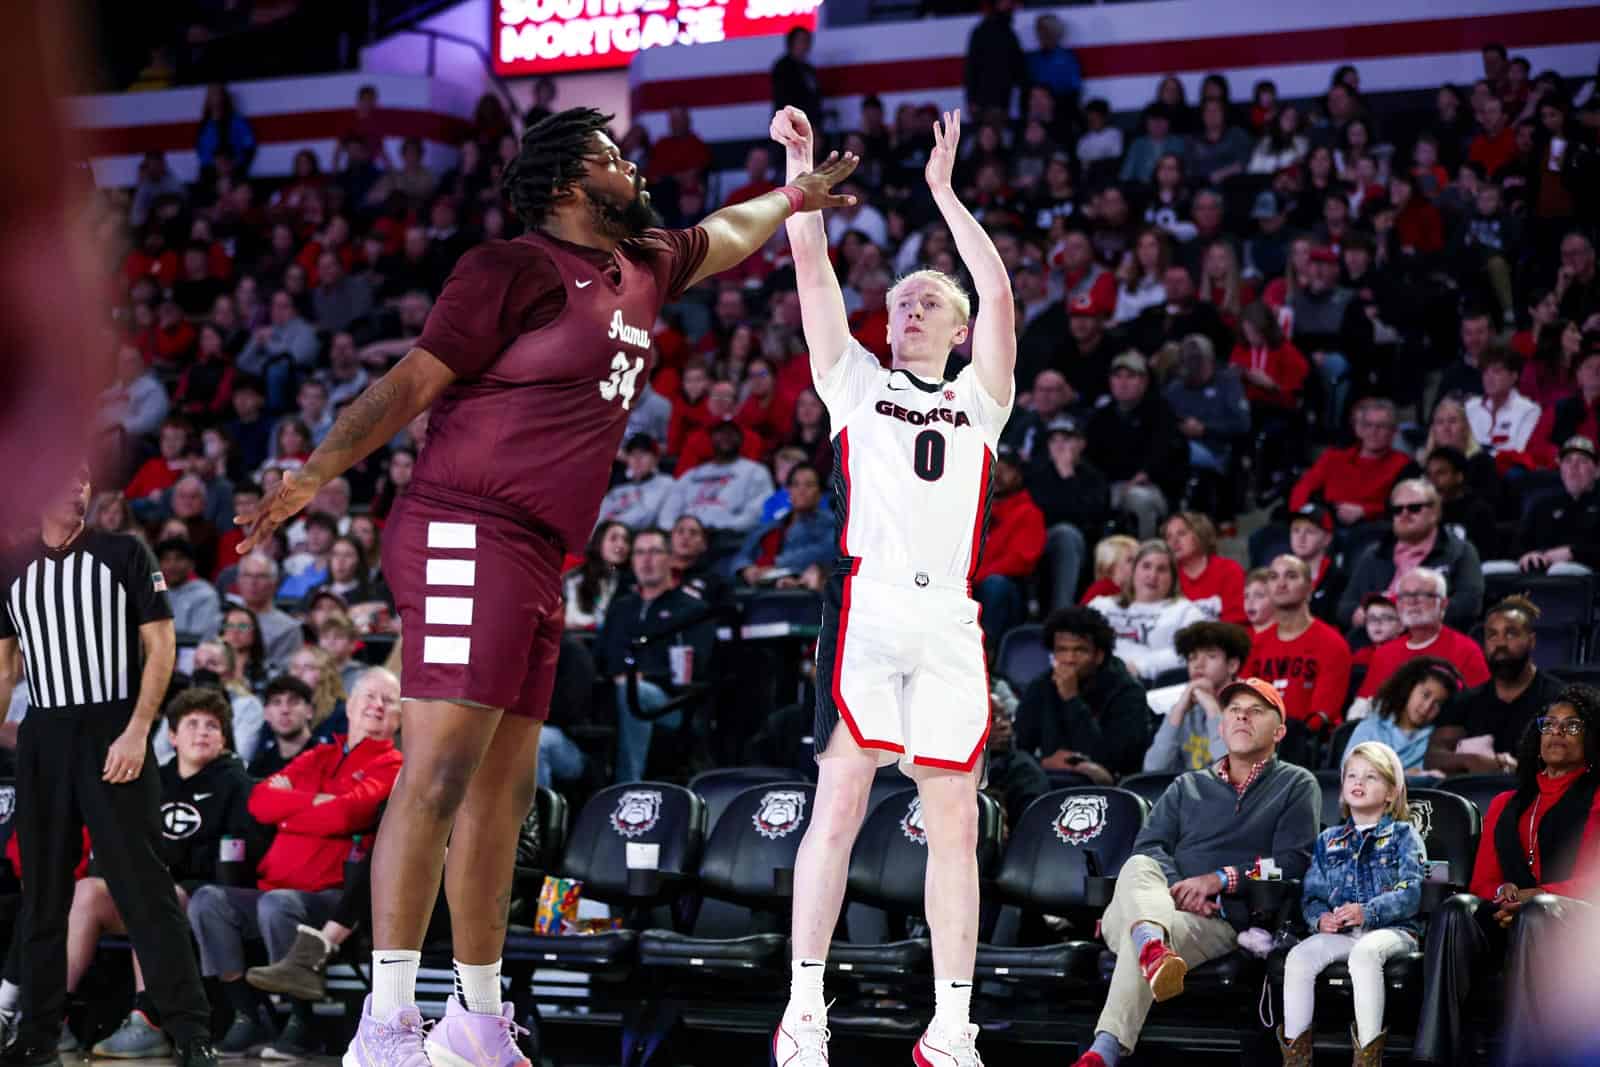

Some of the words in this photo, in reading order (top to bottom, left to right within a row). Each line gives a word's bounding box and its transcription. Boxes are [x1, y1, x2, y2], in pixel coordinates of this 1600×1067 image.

[599, 351, 645, 411] 34
[875, 400, 972, 428] GEORGA
[914, 429, 946, 483] 0
